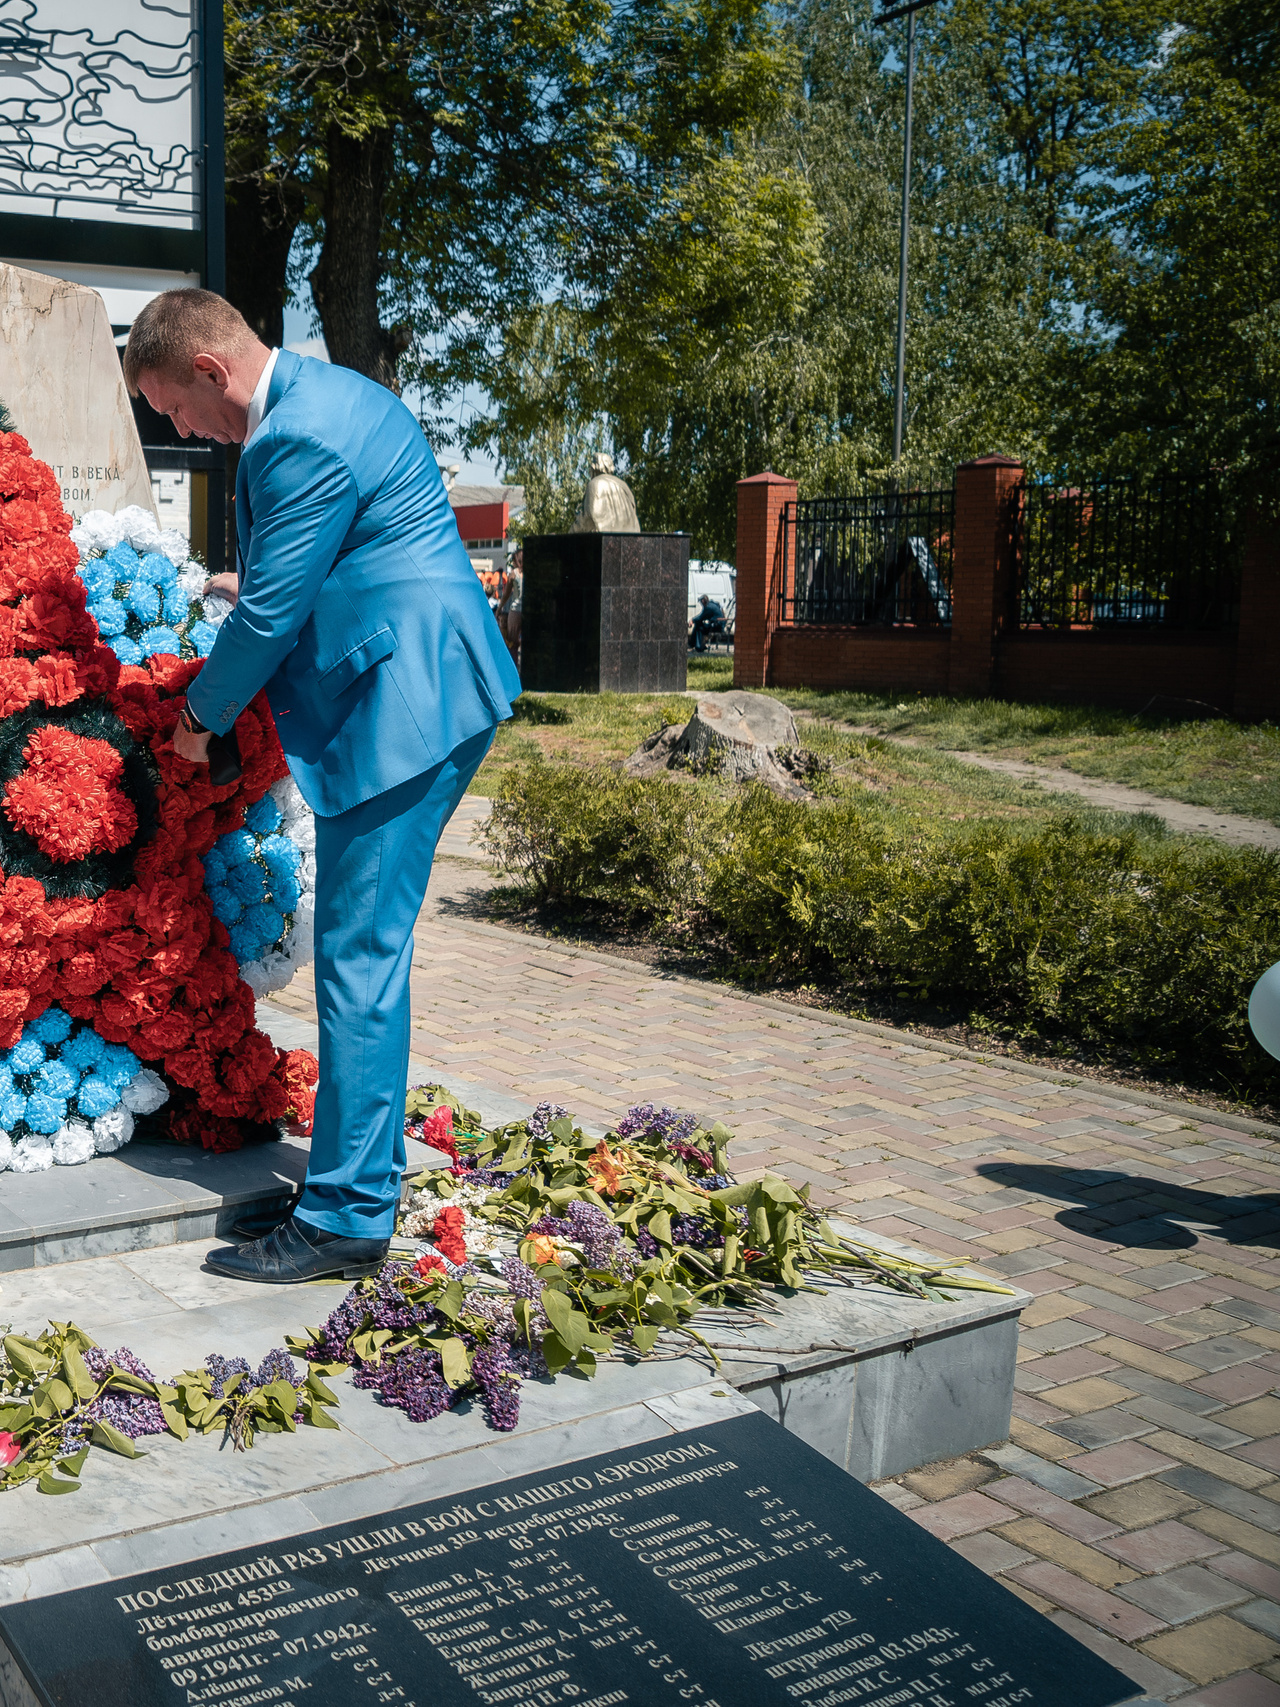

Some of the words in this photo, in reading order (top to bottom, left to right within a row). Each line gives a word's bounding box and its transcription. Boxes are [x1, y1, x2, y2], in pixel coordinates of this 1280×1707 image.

[114, 1556, 284, 1614] ПОСЛЕДНИЙ
[281, 1547, 328, 1570] РАЗ
[326, 1526, 407, 1560] УШЛИ
[402, 1522, 426, 1538] В
[422, 1505, 479, 1532] БОЙ
[476, 1502, 498, 1517] С
[492, 1476, 592, 1512] НАШЕГО
[593, 1442, 719, 1486] АЭРОДРОМА
[361, 1543, 450, 1575] Лётчики
[484, 1490, 632, 1540] истребительного
[634, 1460, 739, 1497] авиакорпуса
[508, 1536, 534, 1550] 03
[544, 1512, 625, 1541] 07.1943г.
[608, 1512, 680, 1539] Степанов
[622, 1519, 712, 1552] Старокожев
[762, 1497, 784, 1510] л-т
[638, 1537, 702, 1564] Сигарев
[700, 1532, 720, 1546] В.
[716, 1527, 740, 1540] П.
[760, 1514, 778, 1526] ст
[777, 1508, 801, 1522] л-т
[652, 1550, 722, 1578] Смирнов
[722, 1544, 742, 1557] А.
[740, 1538, 760, 1552] Н.
[770, 1528, 794, 1542] мл
[793, 1520, 818, 1534] л-т
[668, 1556, 758, 1592] Супруненко
[756, 1550, 776, 1563] Е.
[772, 1544, 794, 1557] В.
[792, 1540, 810, 1551] ст
[810, 1532, 834, 1546] л-т
[386, 1578, 452, 1604] Блинов
[450, 1572, 472, 1586] В.
[474, 1568, 494, 1580] А.
[508, 1557, 532, 1570] мл
[535, 1548, 560, 1562] л-т
[399, 1586, 482, 1618] Белячков
[480, 1580, 502, 1594] Д.
[502, 1574, 523, 1588] Д.
[546, 1561, 572, 1575] л-т
[411, 1600, 494, 1631] Васильев
[496, 1594, 515, 1607] А.
[512, 1588, 534, 1601] В.
[534, 1582, 560, 1595] мл
[560, 1572, 586, 1588] л-т
[680, 1582, 740, 1606] Тураев
[824, 1546, 849, 1560] л-т
[696, 1594, 763, 1620] Шепель
[760, 1585, 778, 1598] С.
[777, 1580, 798, 1592] Р.
[135, 1601, 234, 1635] Лётчики
[146, 1586, 359, 1652] бомбардировачного
[424, 1620, 490, 1645] Волков
[548, 1595, 574, 1608] мл
[575, 1586, 600, 1600] л-т
[712, 1605, 785, 1634] Шлыков
[782, 1598, 804, 1610] С.
[802, 1590, 822, 1604] К.
[858, 1571, 884, 1586] л-т
[159, 1628, 280, 1670] авиаполка
[170, 1651, 269, 1688] 09.1941г.
[283, 1621, 377, 1656] 07.1942г.
[437, 1635, 502, 1660] Егоров
[500, 1626, 522, 1640] С.
[522, 1619, 548, 1633] М.
[568, 1607, 588, 1620] ст
[588, 1599, 614, 1614] л-т
[450, 1634, 556, 1674] Железников
[557, 1628, 578, 1641] А.
[578, 1622, 598, 1635] А.
[743, 1624, 829, 1661] Лётчики
[764, 1632, 876, 1678] штурмового
[282, 1676, 312, 1692] М.
[353, 1657, 380, 1672] с-т
[366, 1671, 393, 1686] с-т
[463, 1664, 532, 1689] Жичин
[529, 1654, 554, 1669] И.
[555, 1648, 576, 1662] А.
[590, 1635, 617, 1650] мл
[618, 1626, 643, 1641] л-т
[477, 1670, 570, 1704] Запруднов
[631, 1640, 658, 1656] л-т
[534, 1690, 562, 1705] Н.
[562, 1682, 588, 1696] Ф.
[648, 1654, 673, 1668] с-т
[663, 1668, 688, 1683] с-т
[786, 1652, 886, 1697] авиаполка
[878, 1626, 960, 1661] 03.1943г.
[856, 1677, 883, 1692] И.
[878, 1670, 902, 1684] С.
[926, 1652, 953, 1666] мл
[950, 1642, 976, 1658] л-т
[908, 1679, 936, 1694] П.
[927, 1672, 952, 1686] Г.
[970, 1657, 996, 1672] с-т
[187, 1674, 262, 1704] Алёшин
[378, 1686, 406, 1702] л-т
[679, 1683, 704, 1698] с-т
[964, 1682, 991, 1696] мл
[988, 1672, 1014, 1688] л-т
[1008, 1688, 1034, 1702] с-т
